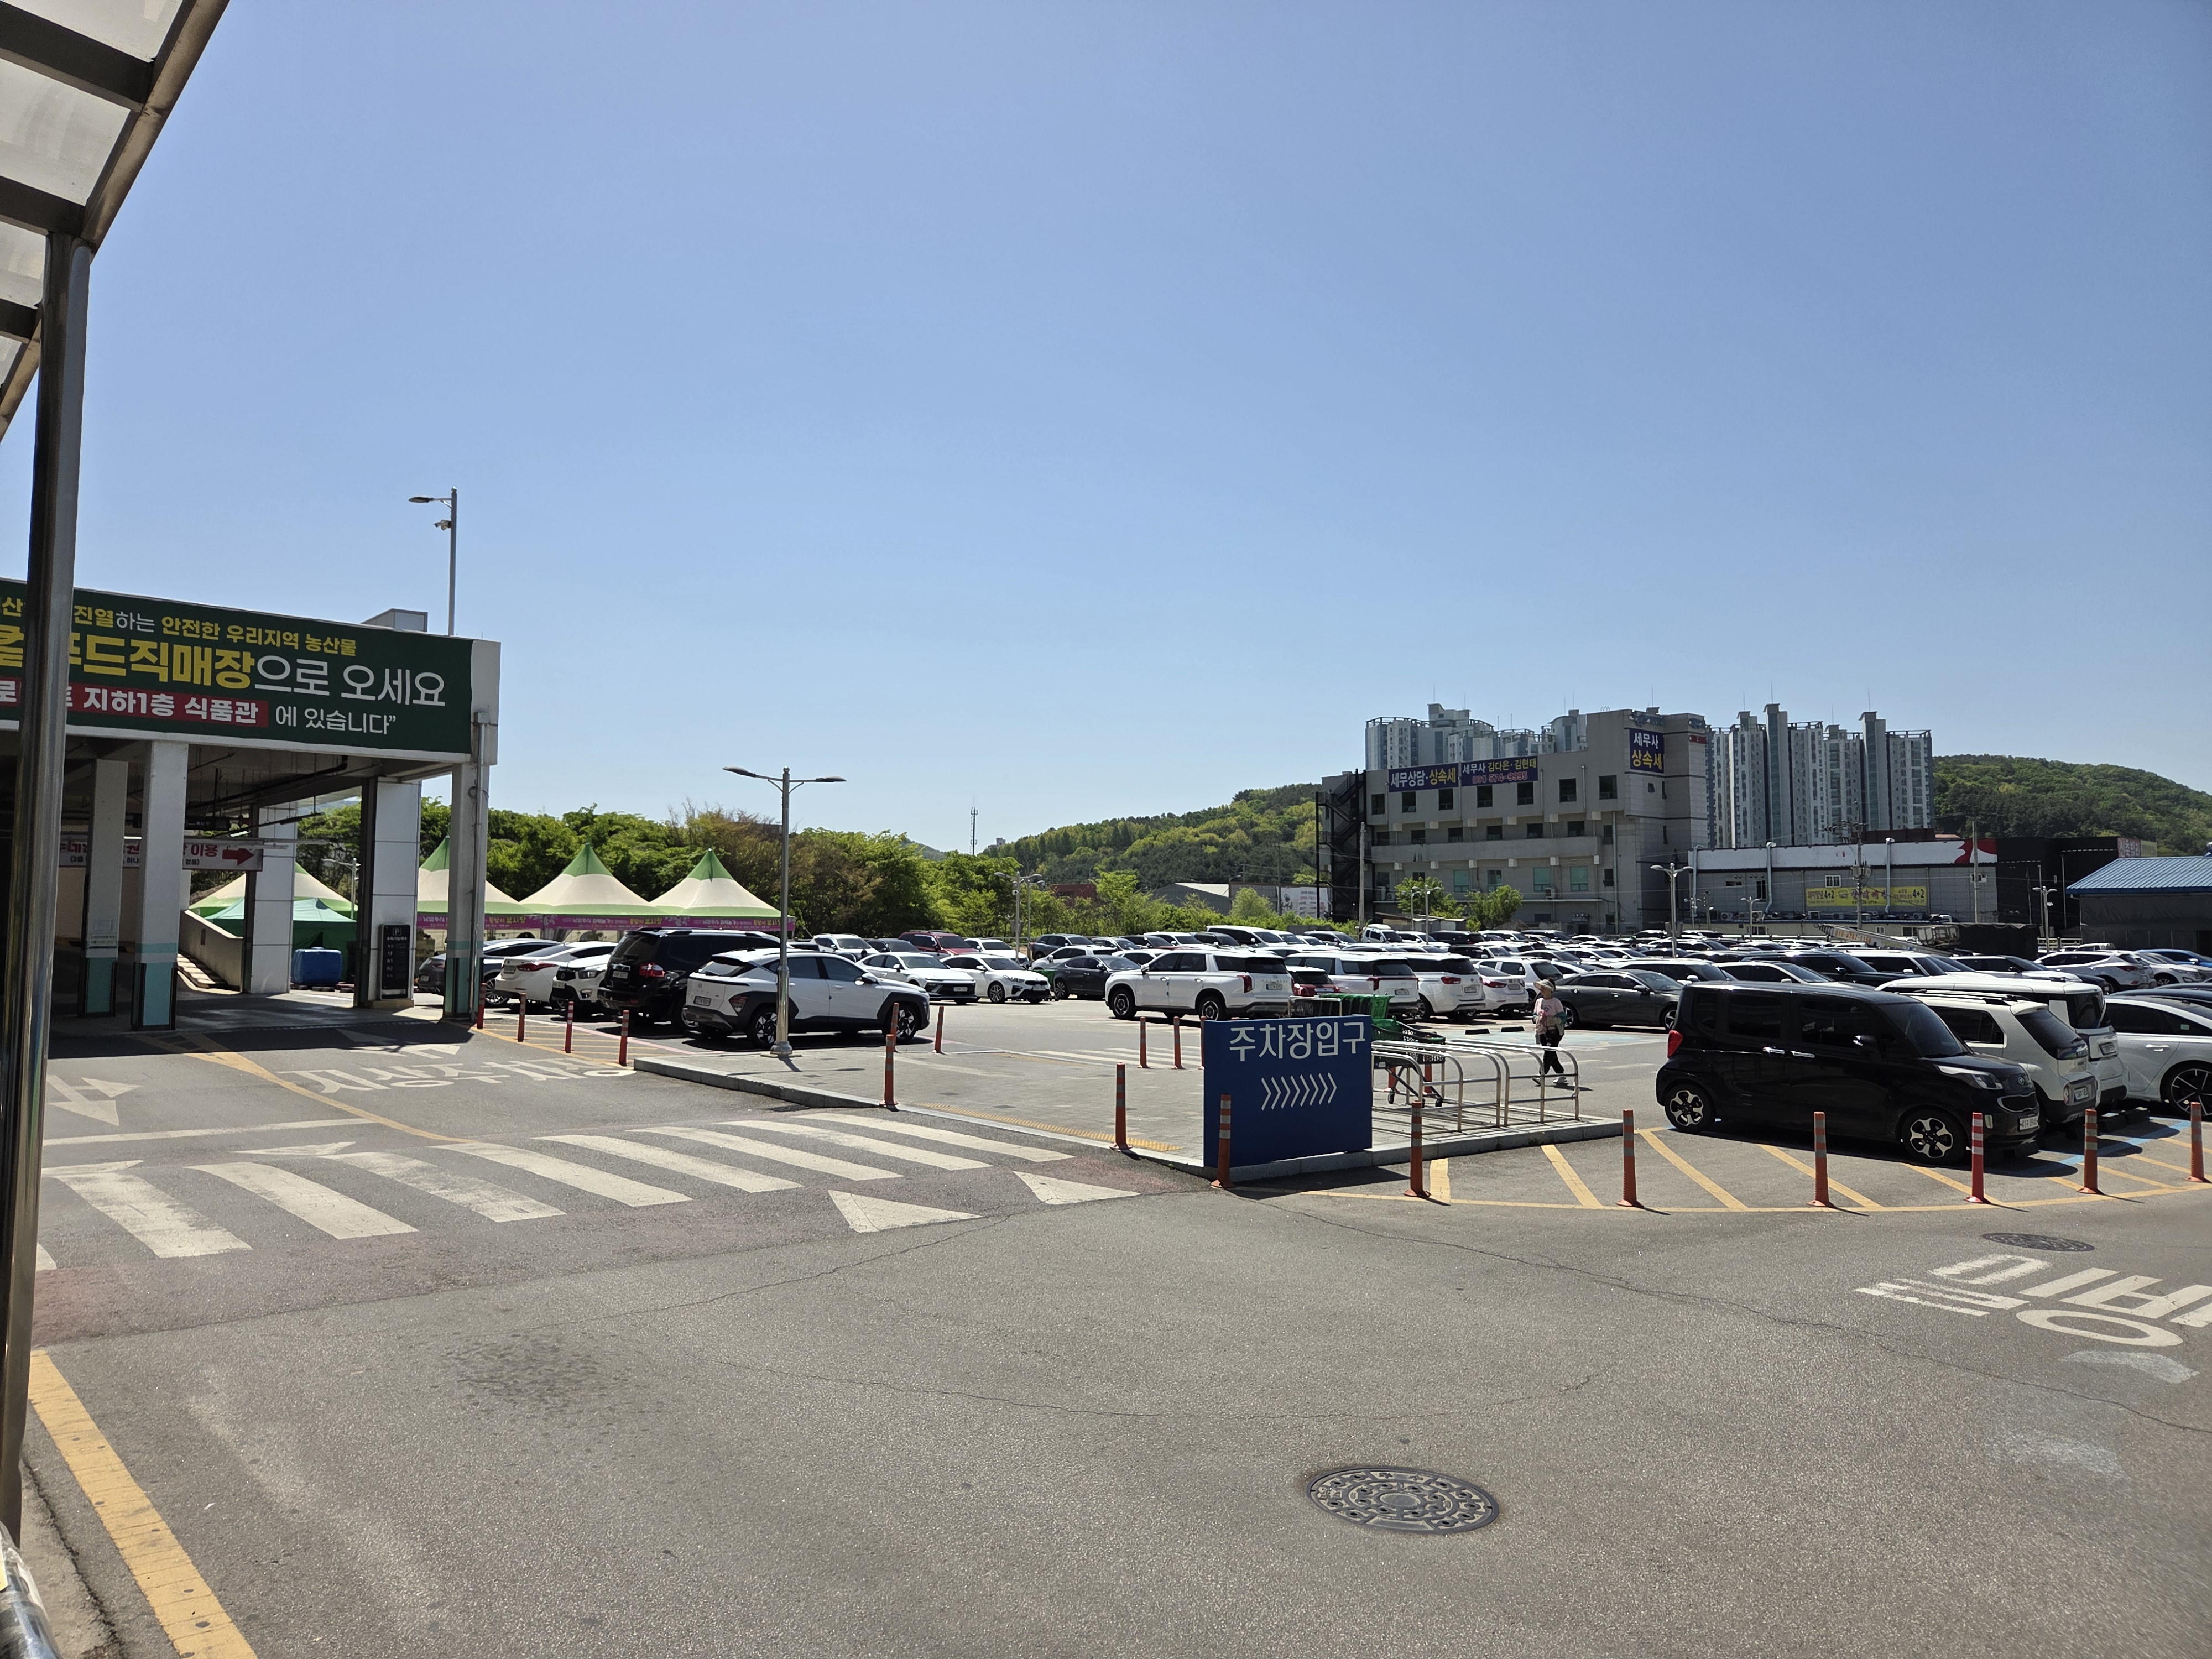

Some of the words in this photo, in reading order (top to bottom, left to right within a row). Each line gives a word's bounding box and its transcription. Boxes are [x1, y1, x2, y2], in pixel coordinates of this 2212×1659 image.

[161, 617, 220, 640] 안전한
[226, 625, 299, 650] 우리지역
[305, 634, 356, 656] 농산물
[69, 632, 330, 696] 드직매장으로
[341, 665, 445, 706] 오세요
[84, 687, 174, 716] 지하1층
[185, 697, 258, 724] 식품관
[275, 706, 296, 727] 에
[1634, 733, 1658, 749] 세무사
[1462, 763, 1486, 774] 세무사
[1632, 750, 1662, 770] 상속세
[190, 844, 218, 857] 이용
[1229, 1021, 1366, 1061] 주차장입구
[277, 1057, 636, 1093] 지상주차장
